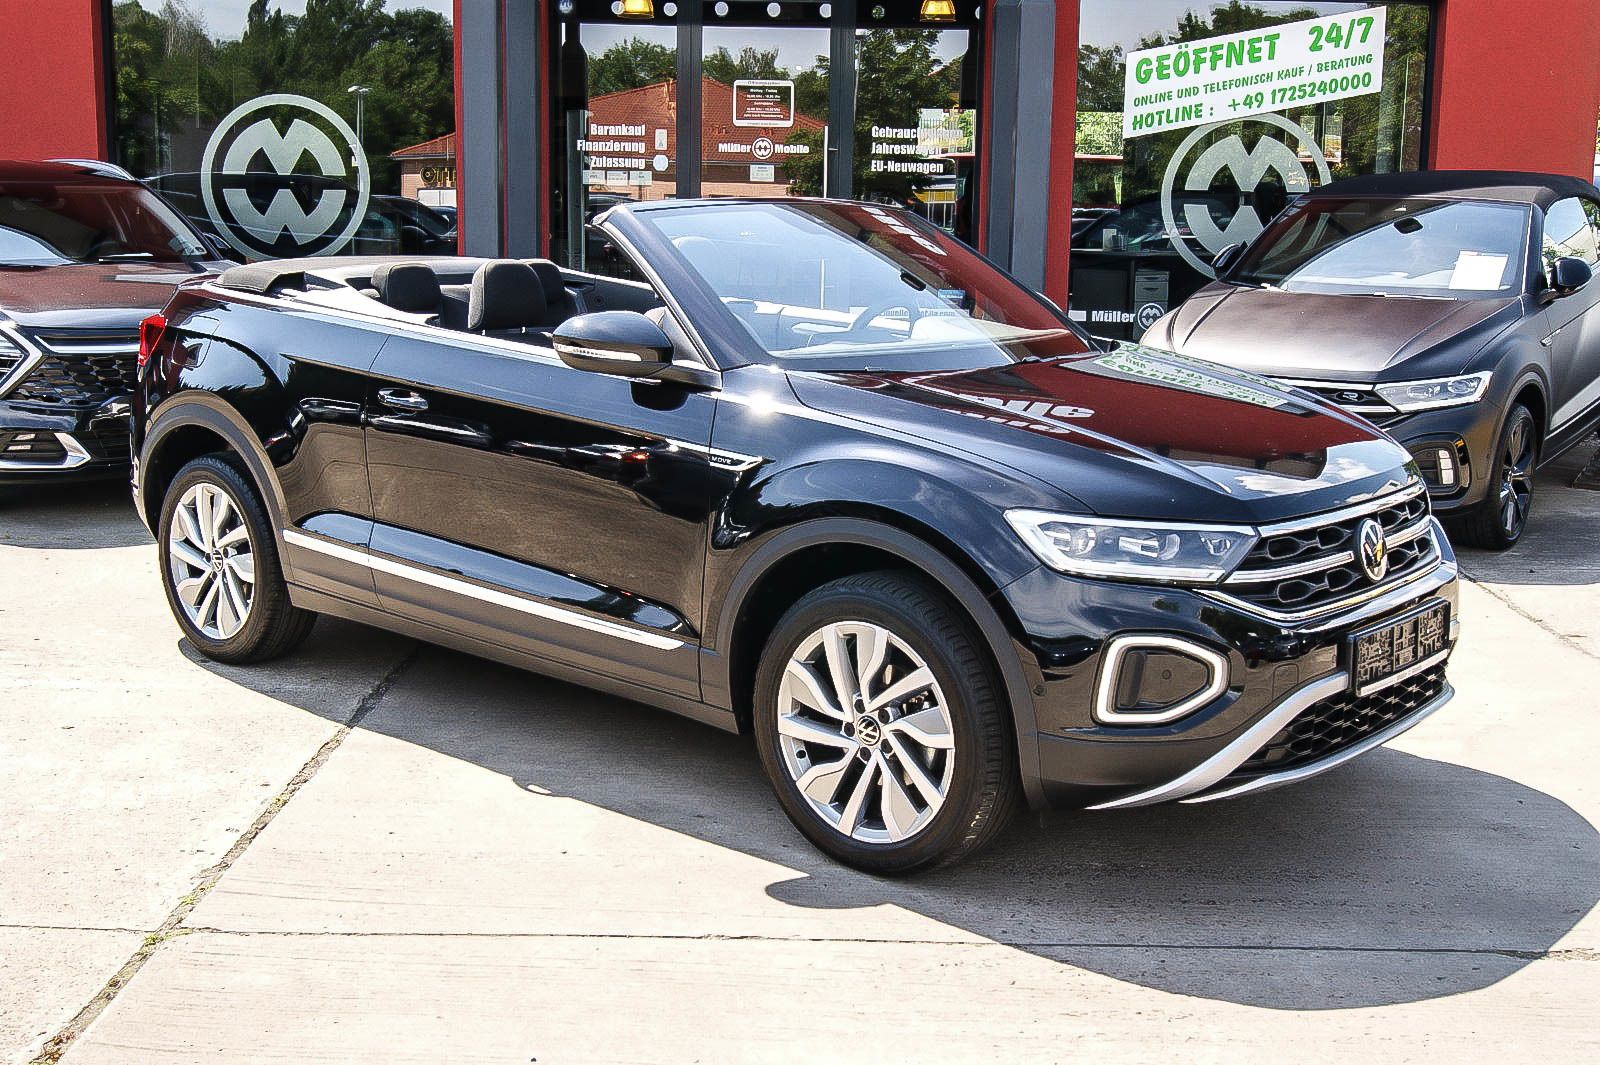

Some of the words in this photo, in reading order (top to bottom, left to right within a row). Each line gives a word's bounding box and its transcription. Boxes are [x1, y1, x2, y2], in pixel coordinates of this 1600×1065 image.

[1135, 33, 1280, 84] GEÖFFNET
[1308, 16, 1375, 52] 24/7
[1133, 90, 1173, 107] ONLINE
[1177, 86, 1199, 99] UND
[1203, 72, 1273, 94] TELEFONISCH
[1277, 66, 1305, 81] KAUF
[1316, 53, 1374, 73] BERATUNG
[1132, 103, 1203, 131] HOTLINE
[1228, 92, 1264, 112] +49
[1271, 71, 1372, 105] 1725240000
[590, 123, 646, 137] Barankauf
[576, 139, 646, 154] Finanzierung
[718, 142, 752, 153] Müller
[774, 143, 810, 154] Mobile
[590, 155, 646, 170] Zulassung
[871, 159, 944, 174] EU-Neuwagen
[1091, 310, 1136, 323] Müller
[711, 456, 732, 465] MOVE
